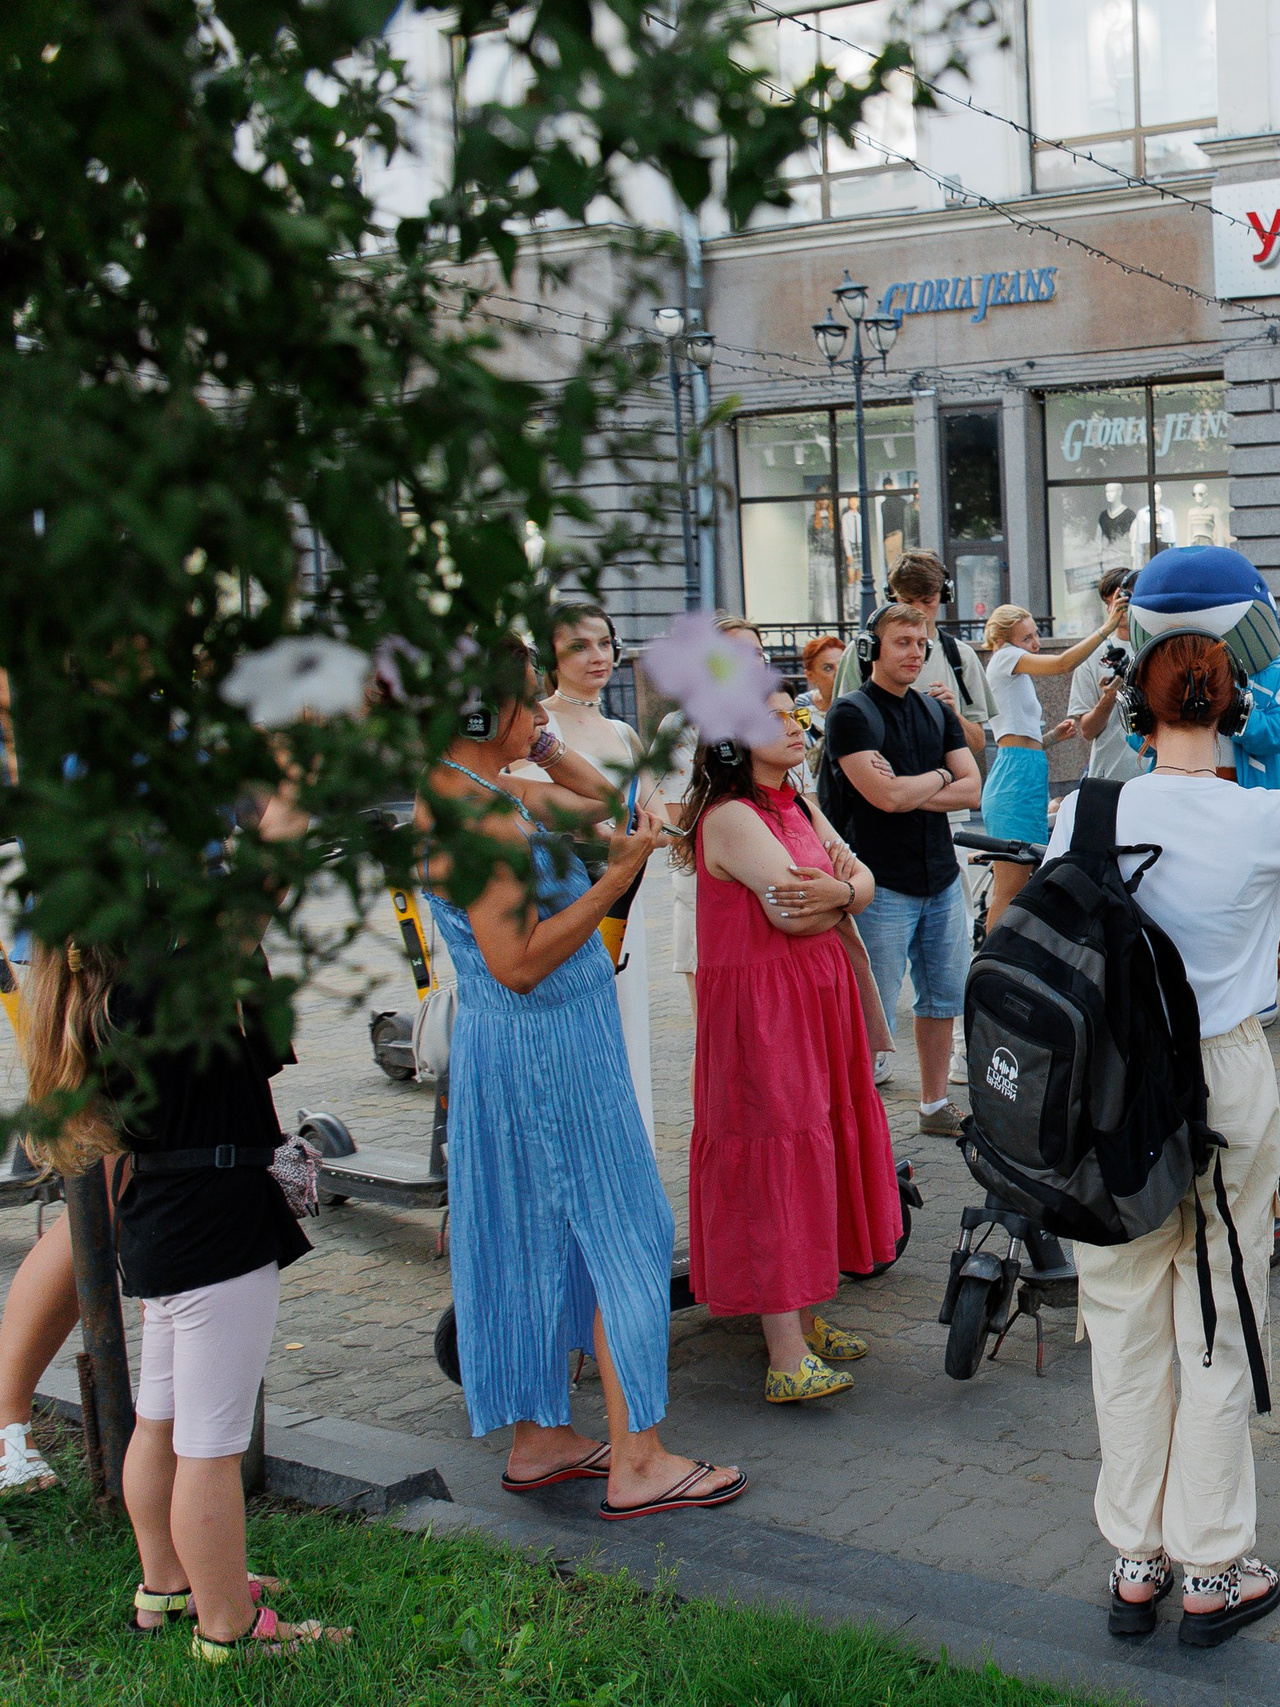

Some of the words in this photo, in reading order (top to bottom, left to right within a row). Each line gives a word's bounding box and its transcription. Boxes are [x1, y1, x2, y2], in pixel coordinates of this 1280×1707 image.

[882, 276, 973, 328] GLORIA
[971, 267, 1058, 323] JEANS
[1061, 415, 1147, 462] GLORIA
[1156, 410, 1229, 457] JEANS
[986, 1074, 1017, 1102] ВНУТРИ
[987, 1066, 1018, 1093] ГОЛОС
